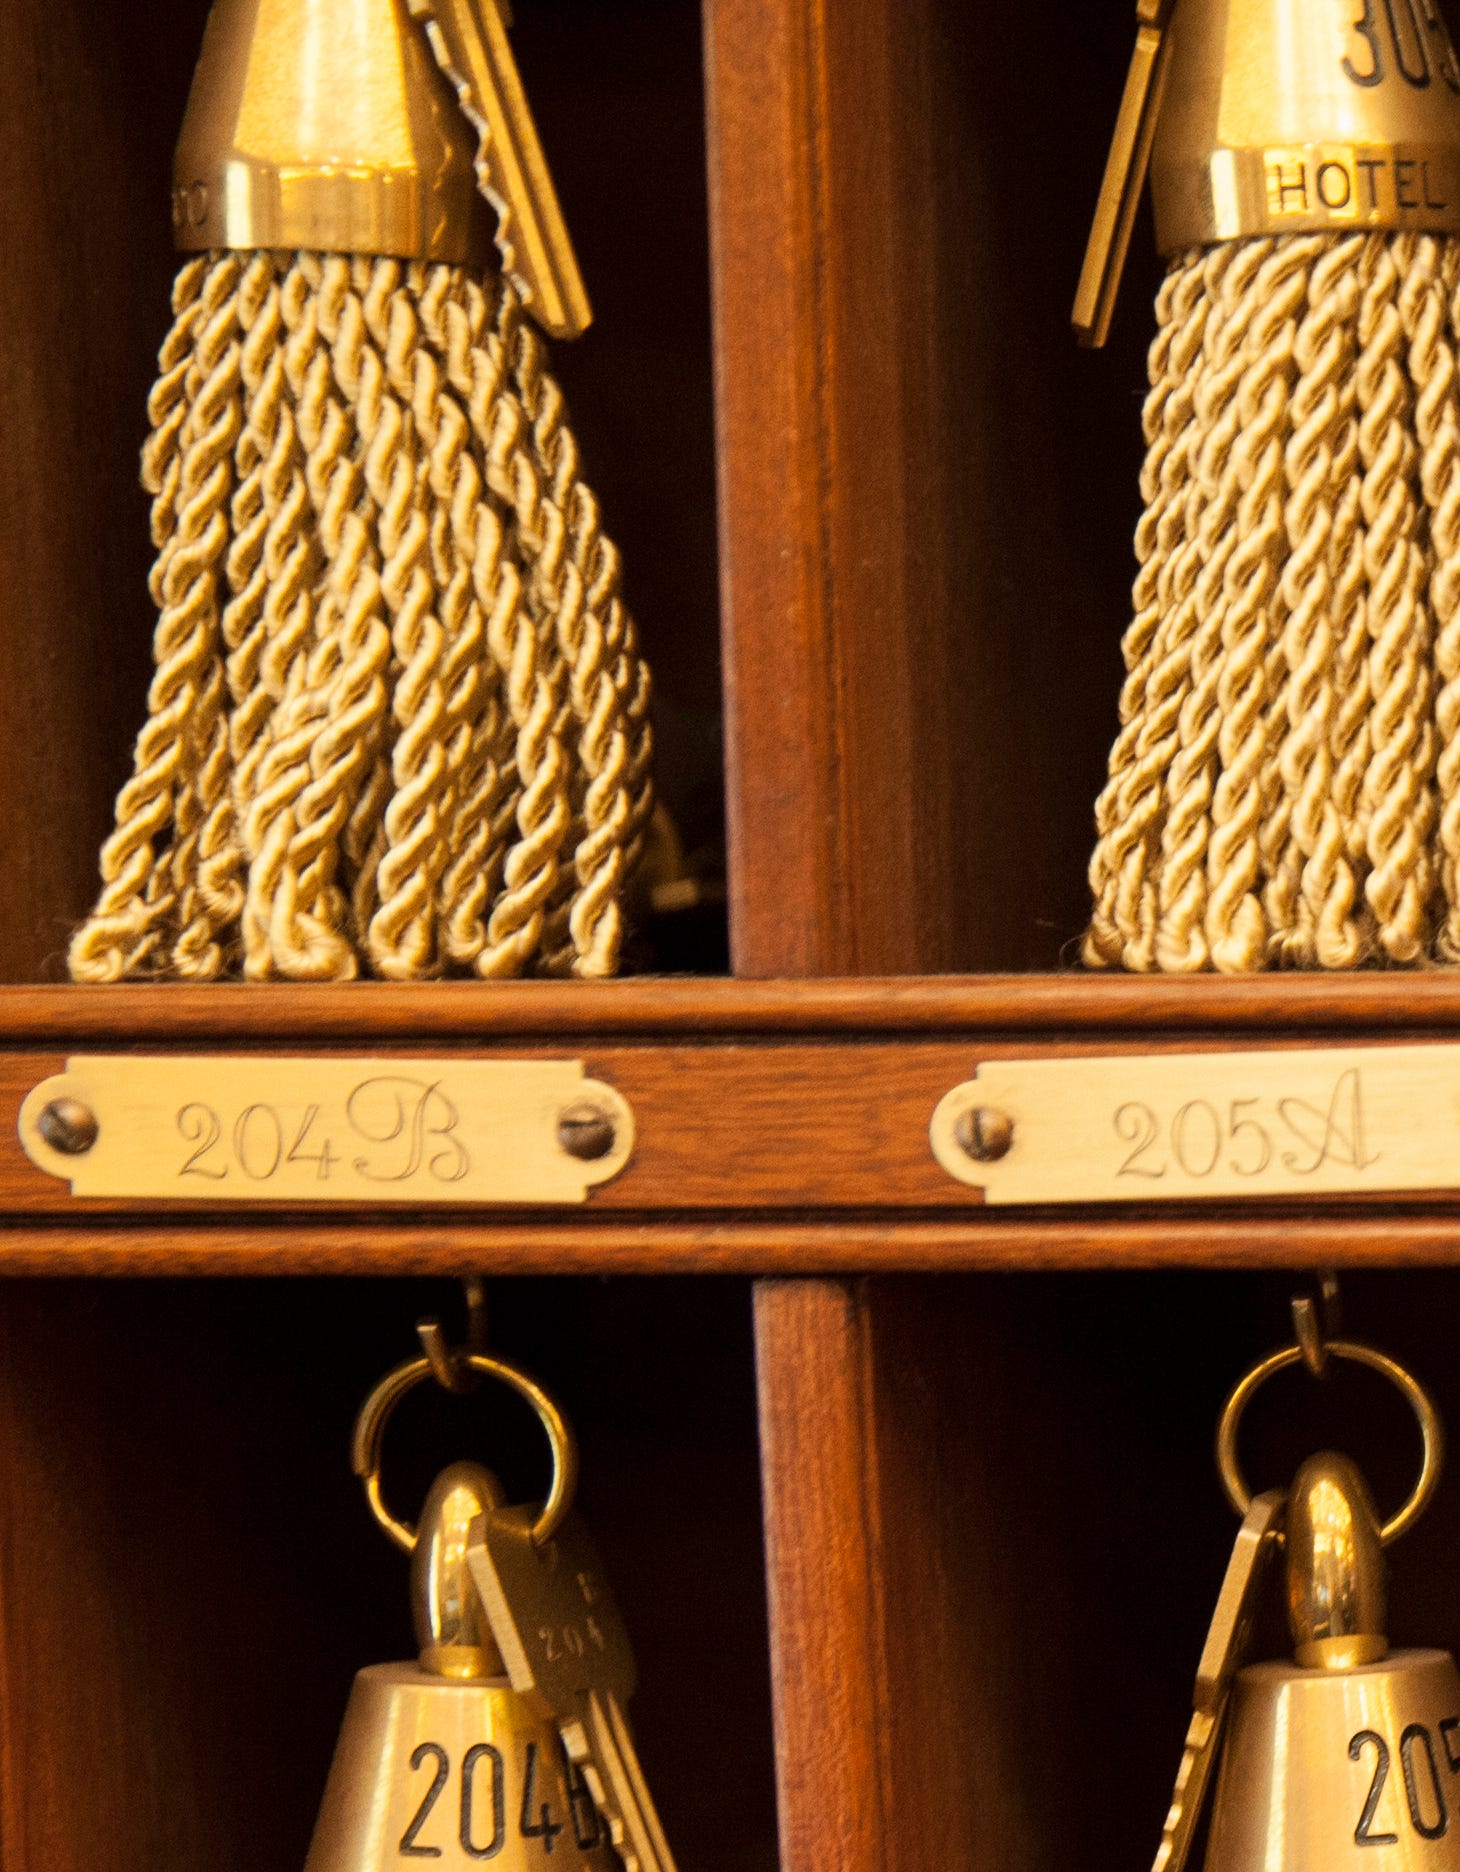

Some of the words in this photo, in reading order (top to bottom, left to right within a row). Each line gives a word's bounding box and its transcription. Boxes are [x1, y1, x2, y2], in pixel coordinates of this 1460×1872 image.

[1275, 159, 1449, 212] HOTEL
[176, 1075, 471, 1183] 204B
[1112, 1067, 1382, 1180] 205A
